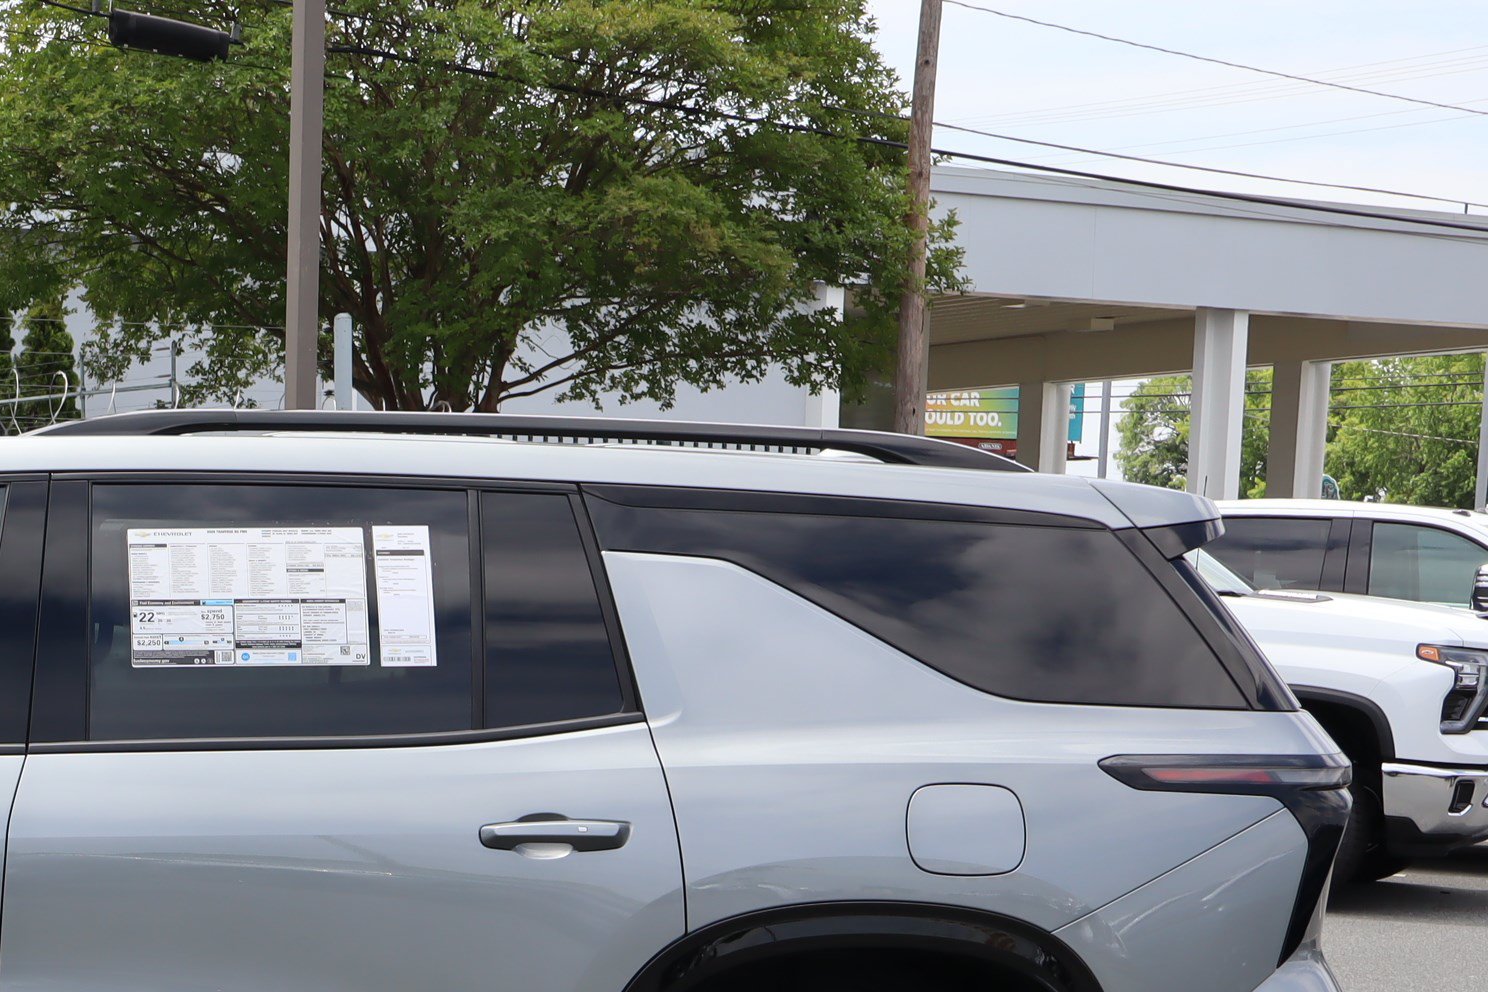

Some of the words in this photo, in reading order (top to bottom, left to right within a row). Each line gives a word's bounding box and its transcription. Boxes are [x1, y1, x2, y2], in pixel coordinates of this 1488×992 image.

[926, 392, 947, 406] UR
[951, 392, 980, 407] CAR
[924, 409, 965, 425] OULD
[968, 411, 1002, 427] TOO.
[139, 611, 155, 623] 22
[201, 613, 225, 621] $2,750
